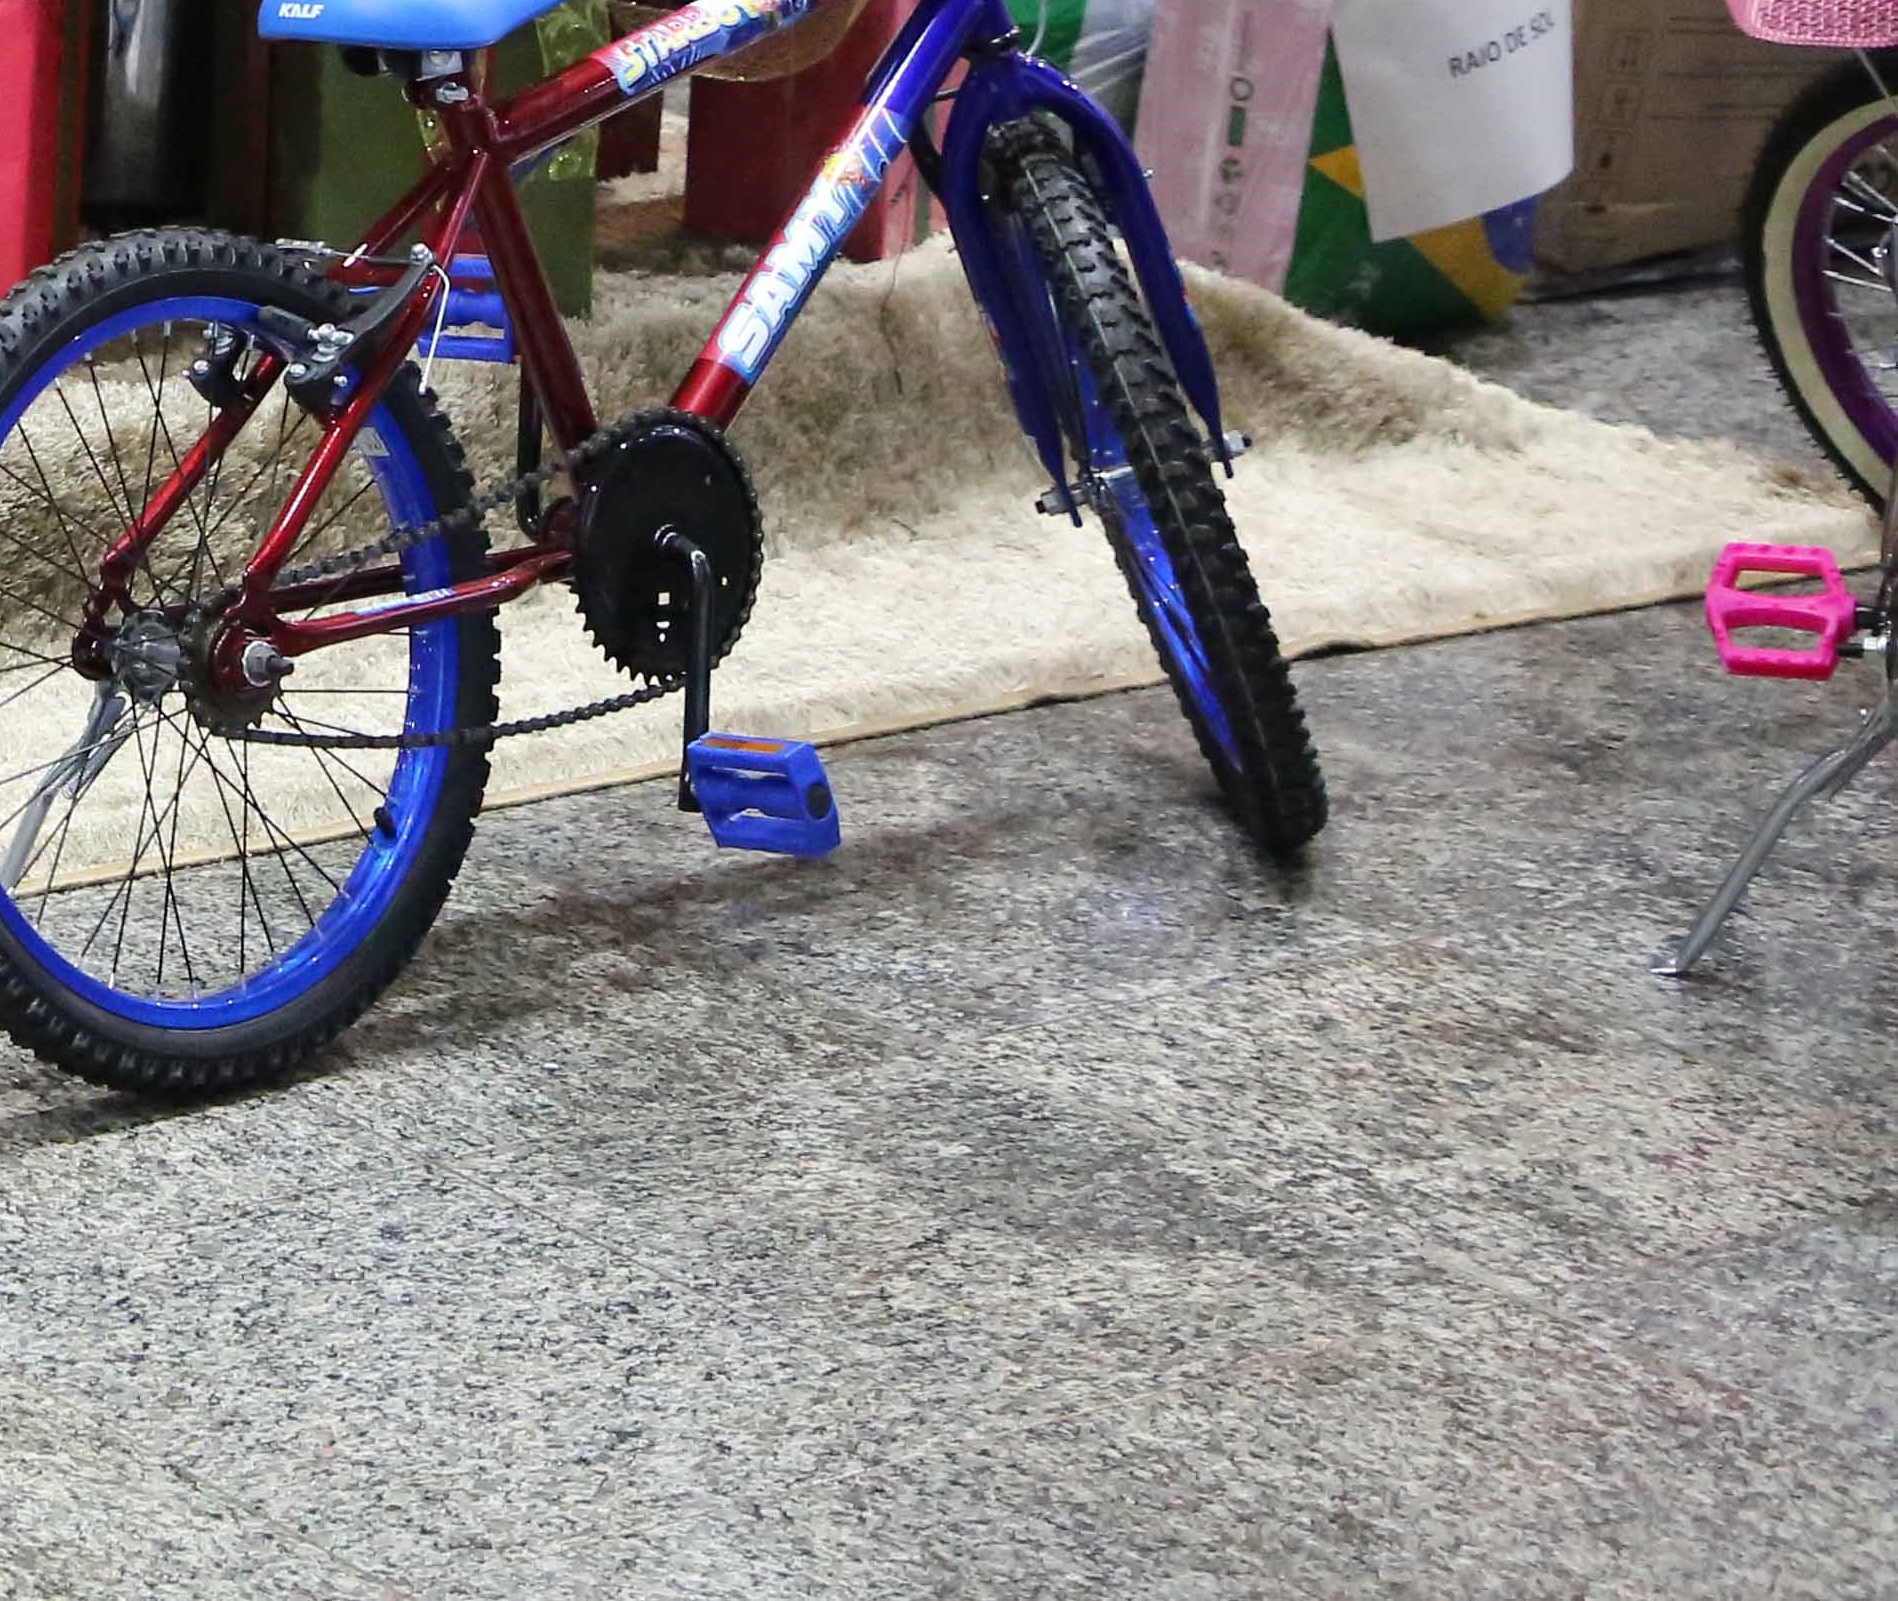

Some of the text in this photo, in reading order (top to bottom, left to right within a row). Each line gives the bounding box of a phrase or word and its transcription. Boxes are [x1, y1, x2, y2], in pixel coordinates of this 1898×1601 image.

[277, 1, 325, 19] KALF
[1448, 40, 1502, 79] RAIO
[1503, 24, 1529, 54] DE
